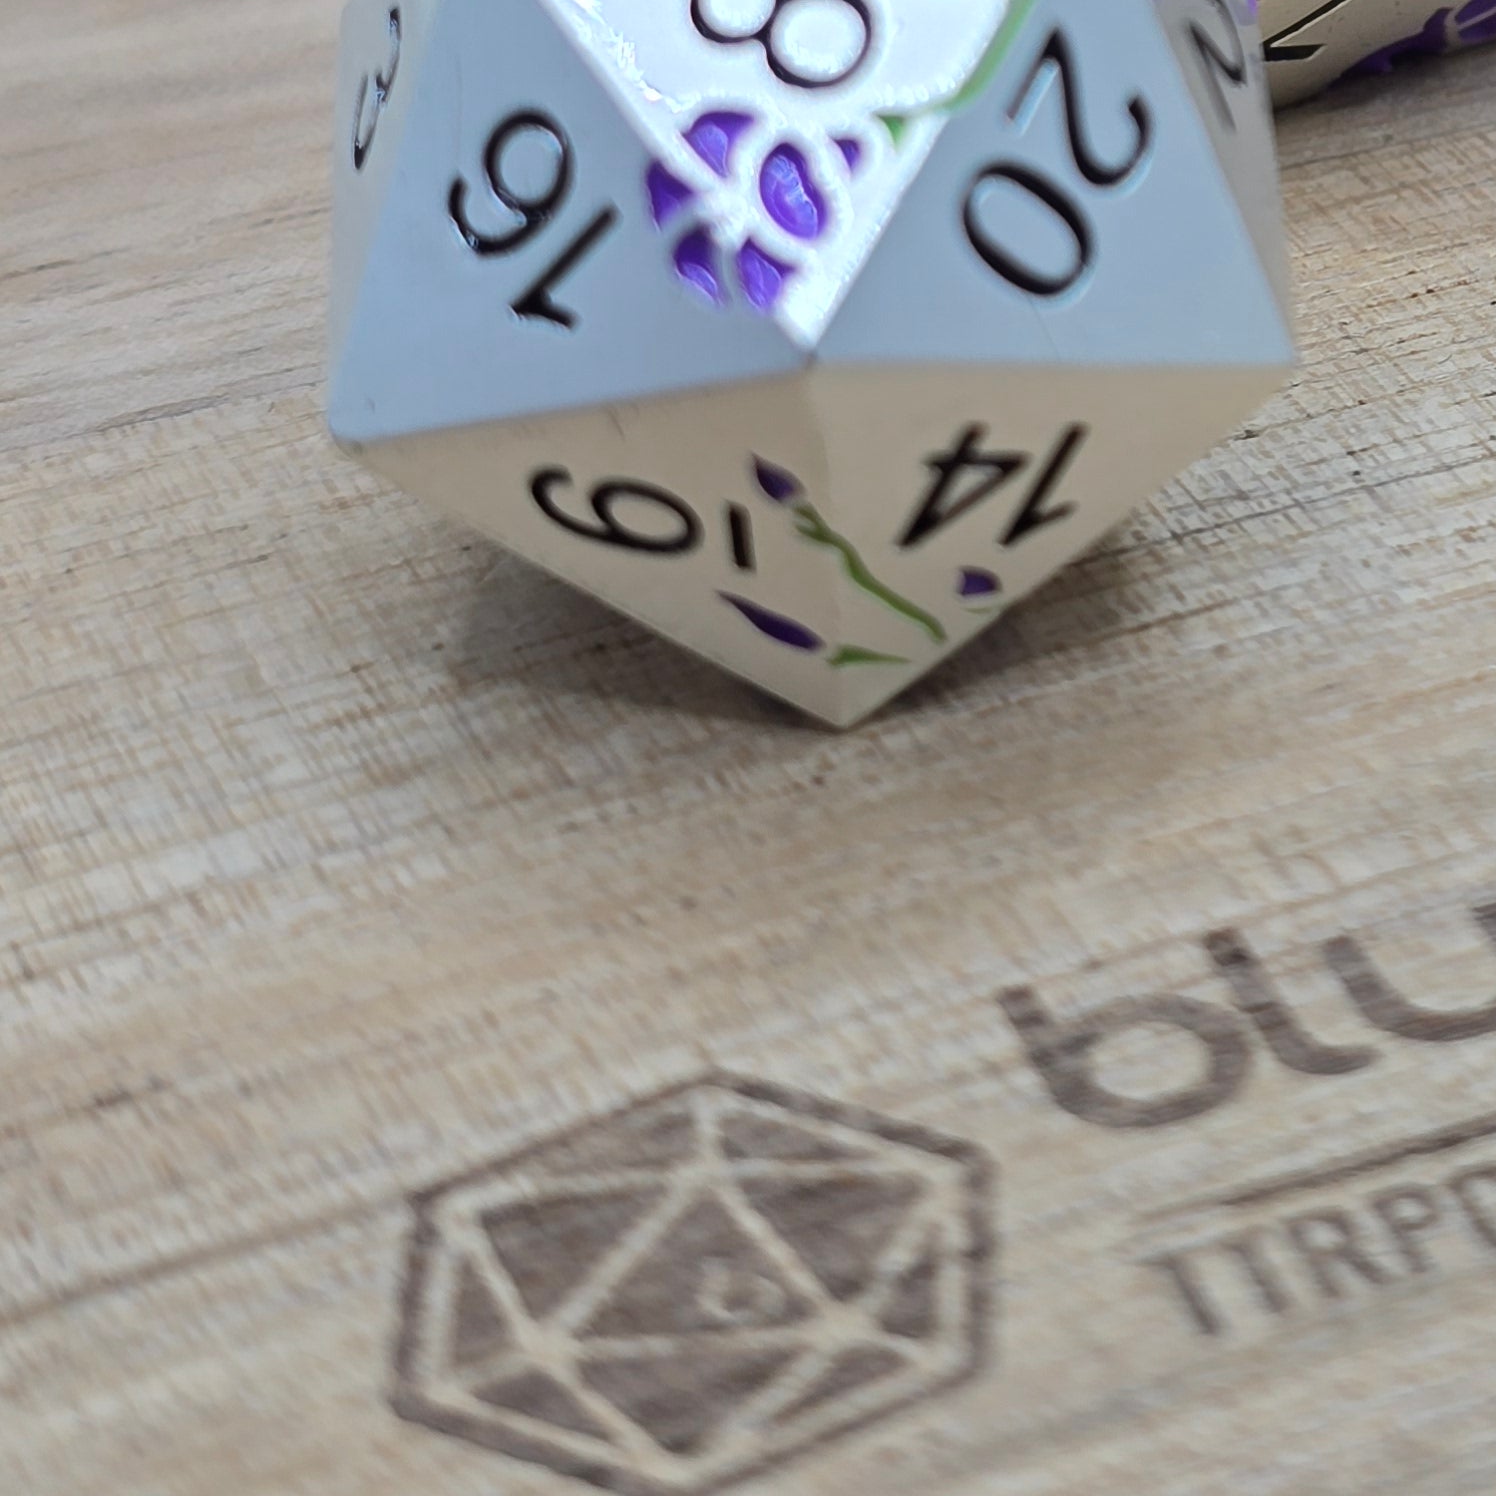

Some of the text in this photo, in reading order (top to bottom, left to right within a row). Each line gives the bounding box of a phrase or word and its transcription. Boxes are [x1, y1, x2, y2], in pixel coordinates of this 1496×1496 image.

[447, 108, 618, 330] 16
[960, 28, 1153, 298] 20
[894, 420, 1090, 550] 14
